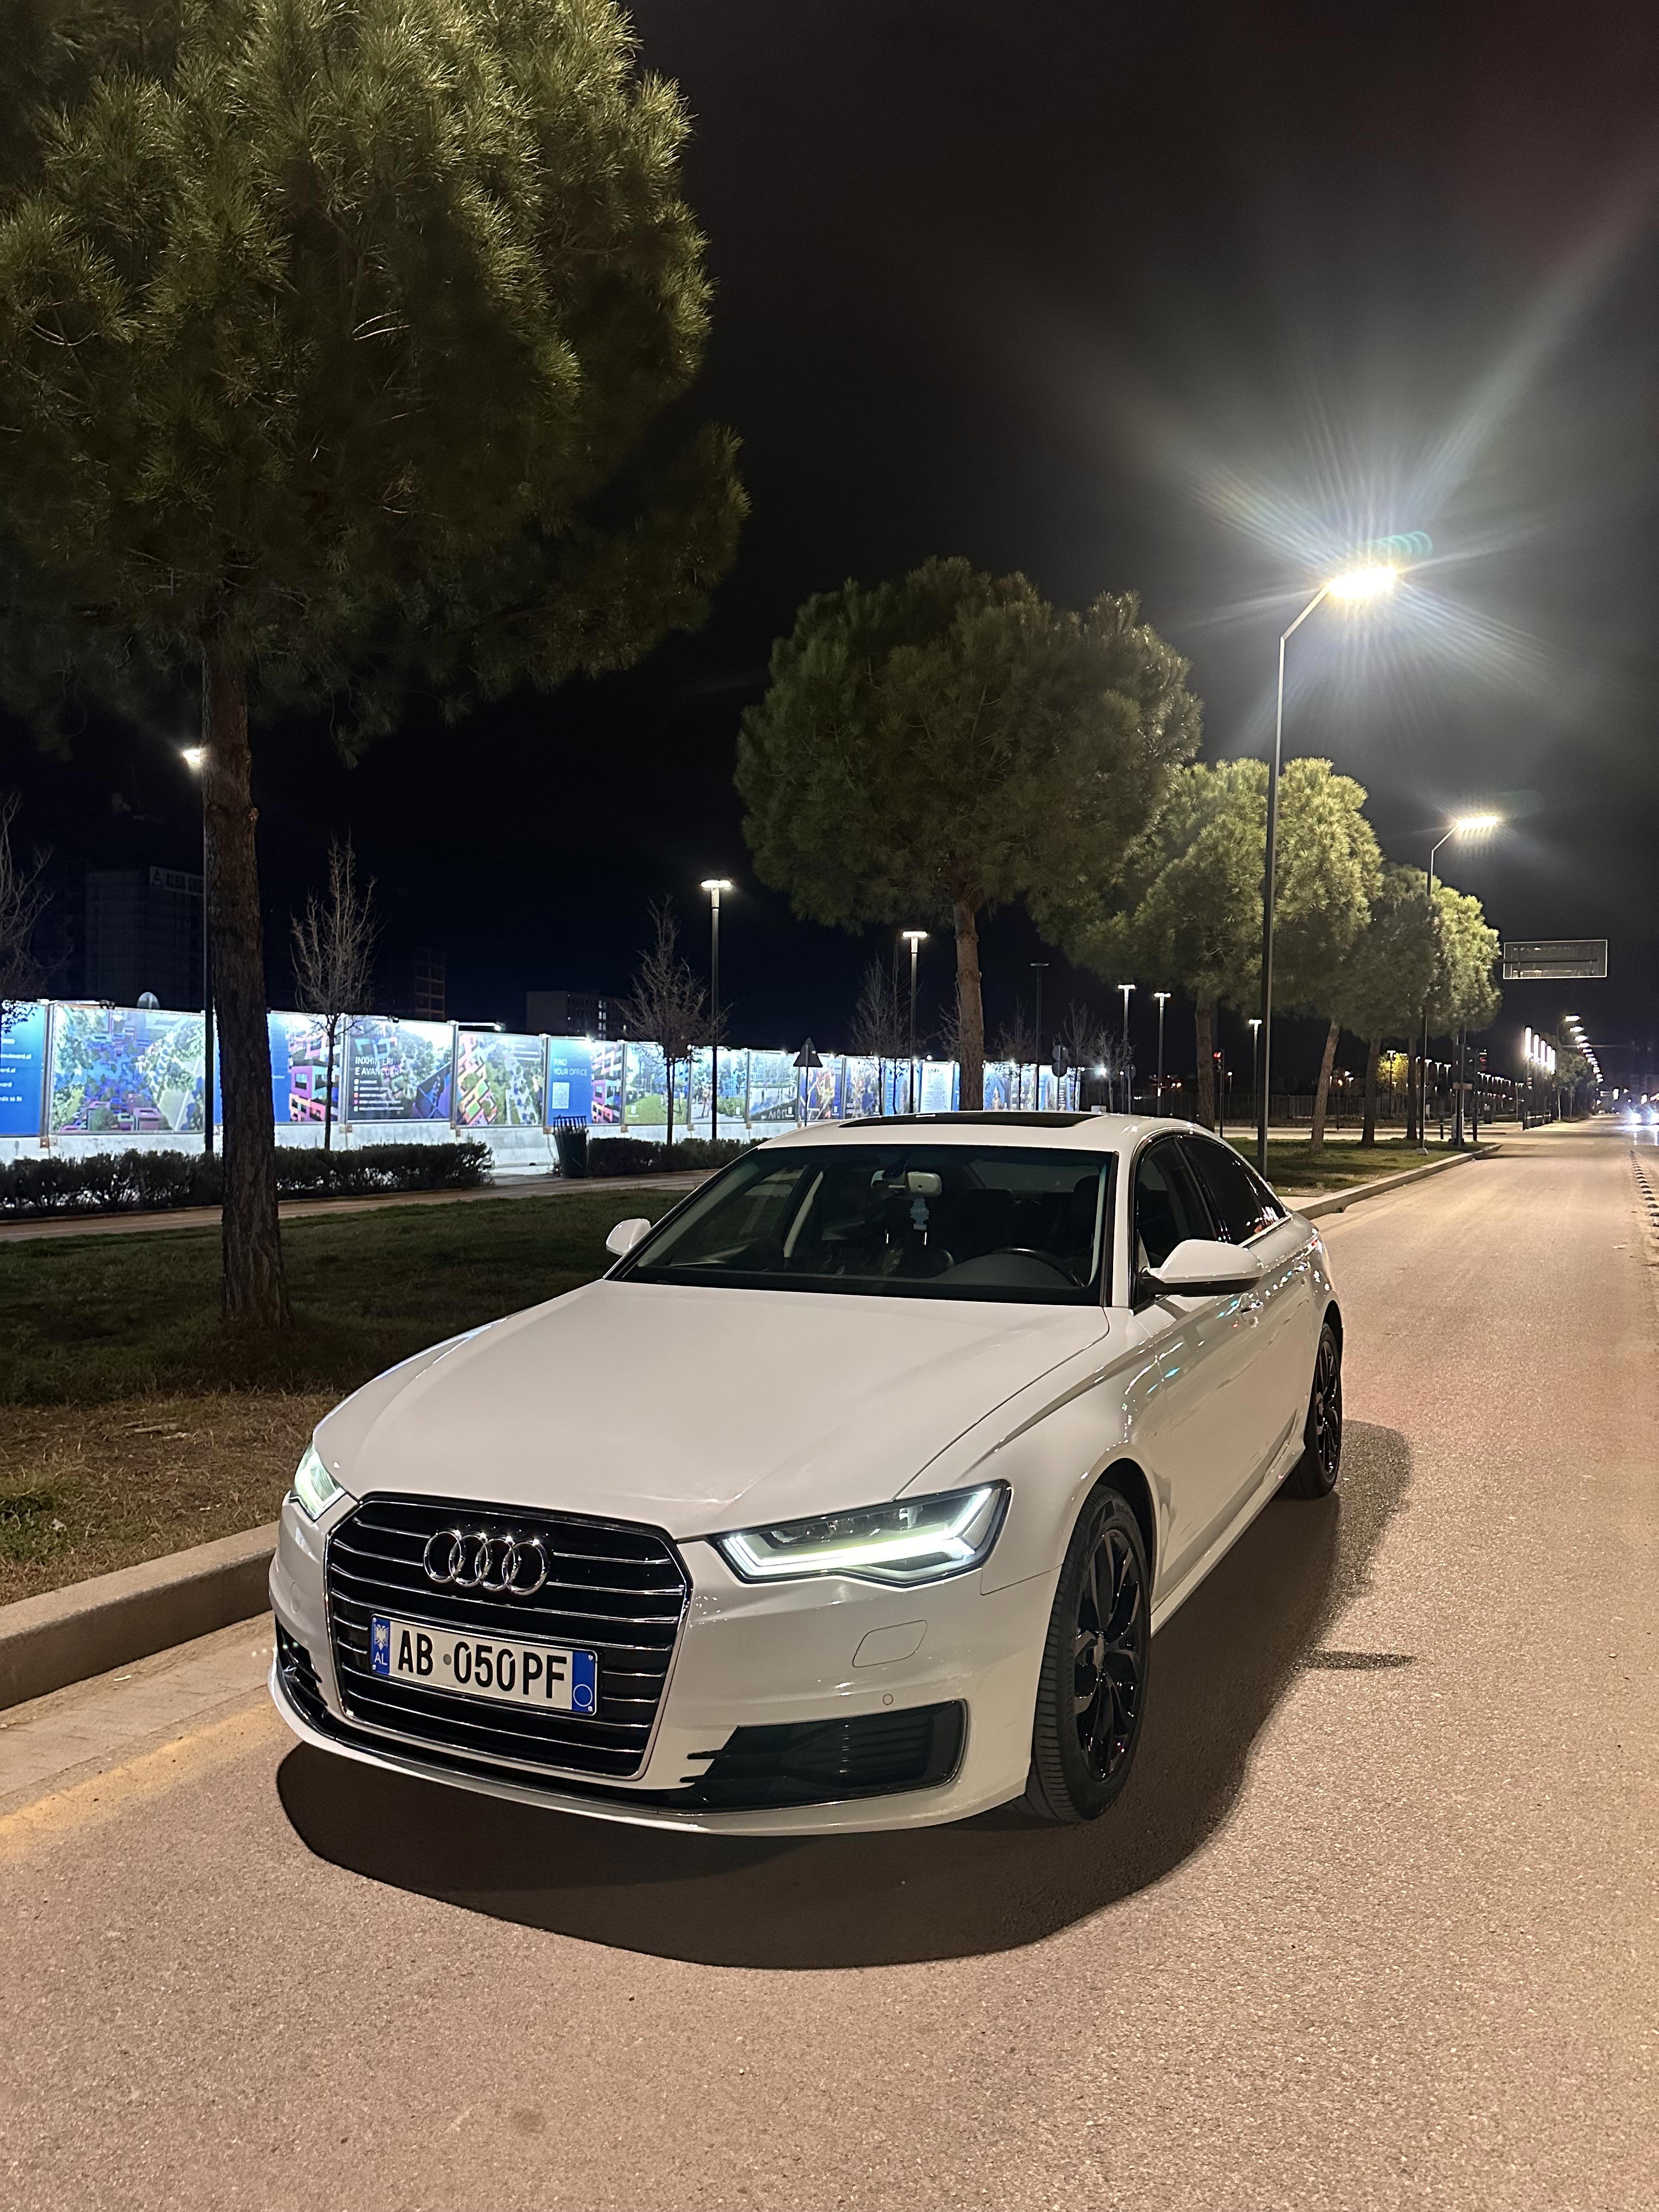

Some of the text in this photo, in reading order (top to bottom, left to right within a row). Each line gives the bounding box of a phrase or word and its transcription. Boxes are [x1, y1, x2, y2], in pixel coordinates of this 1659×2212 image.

[554, 1058, 567, 1066] FIND
[355, 1066, 360, 1075] E
[553, 1067, 568, 1075] YOUR
[398, 1629, 433, 1676] AB
[374, 1652, 388, 1666] AL
